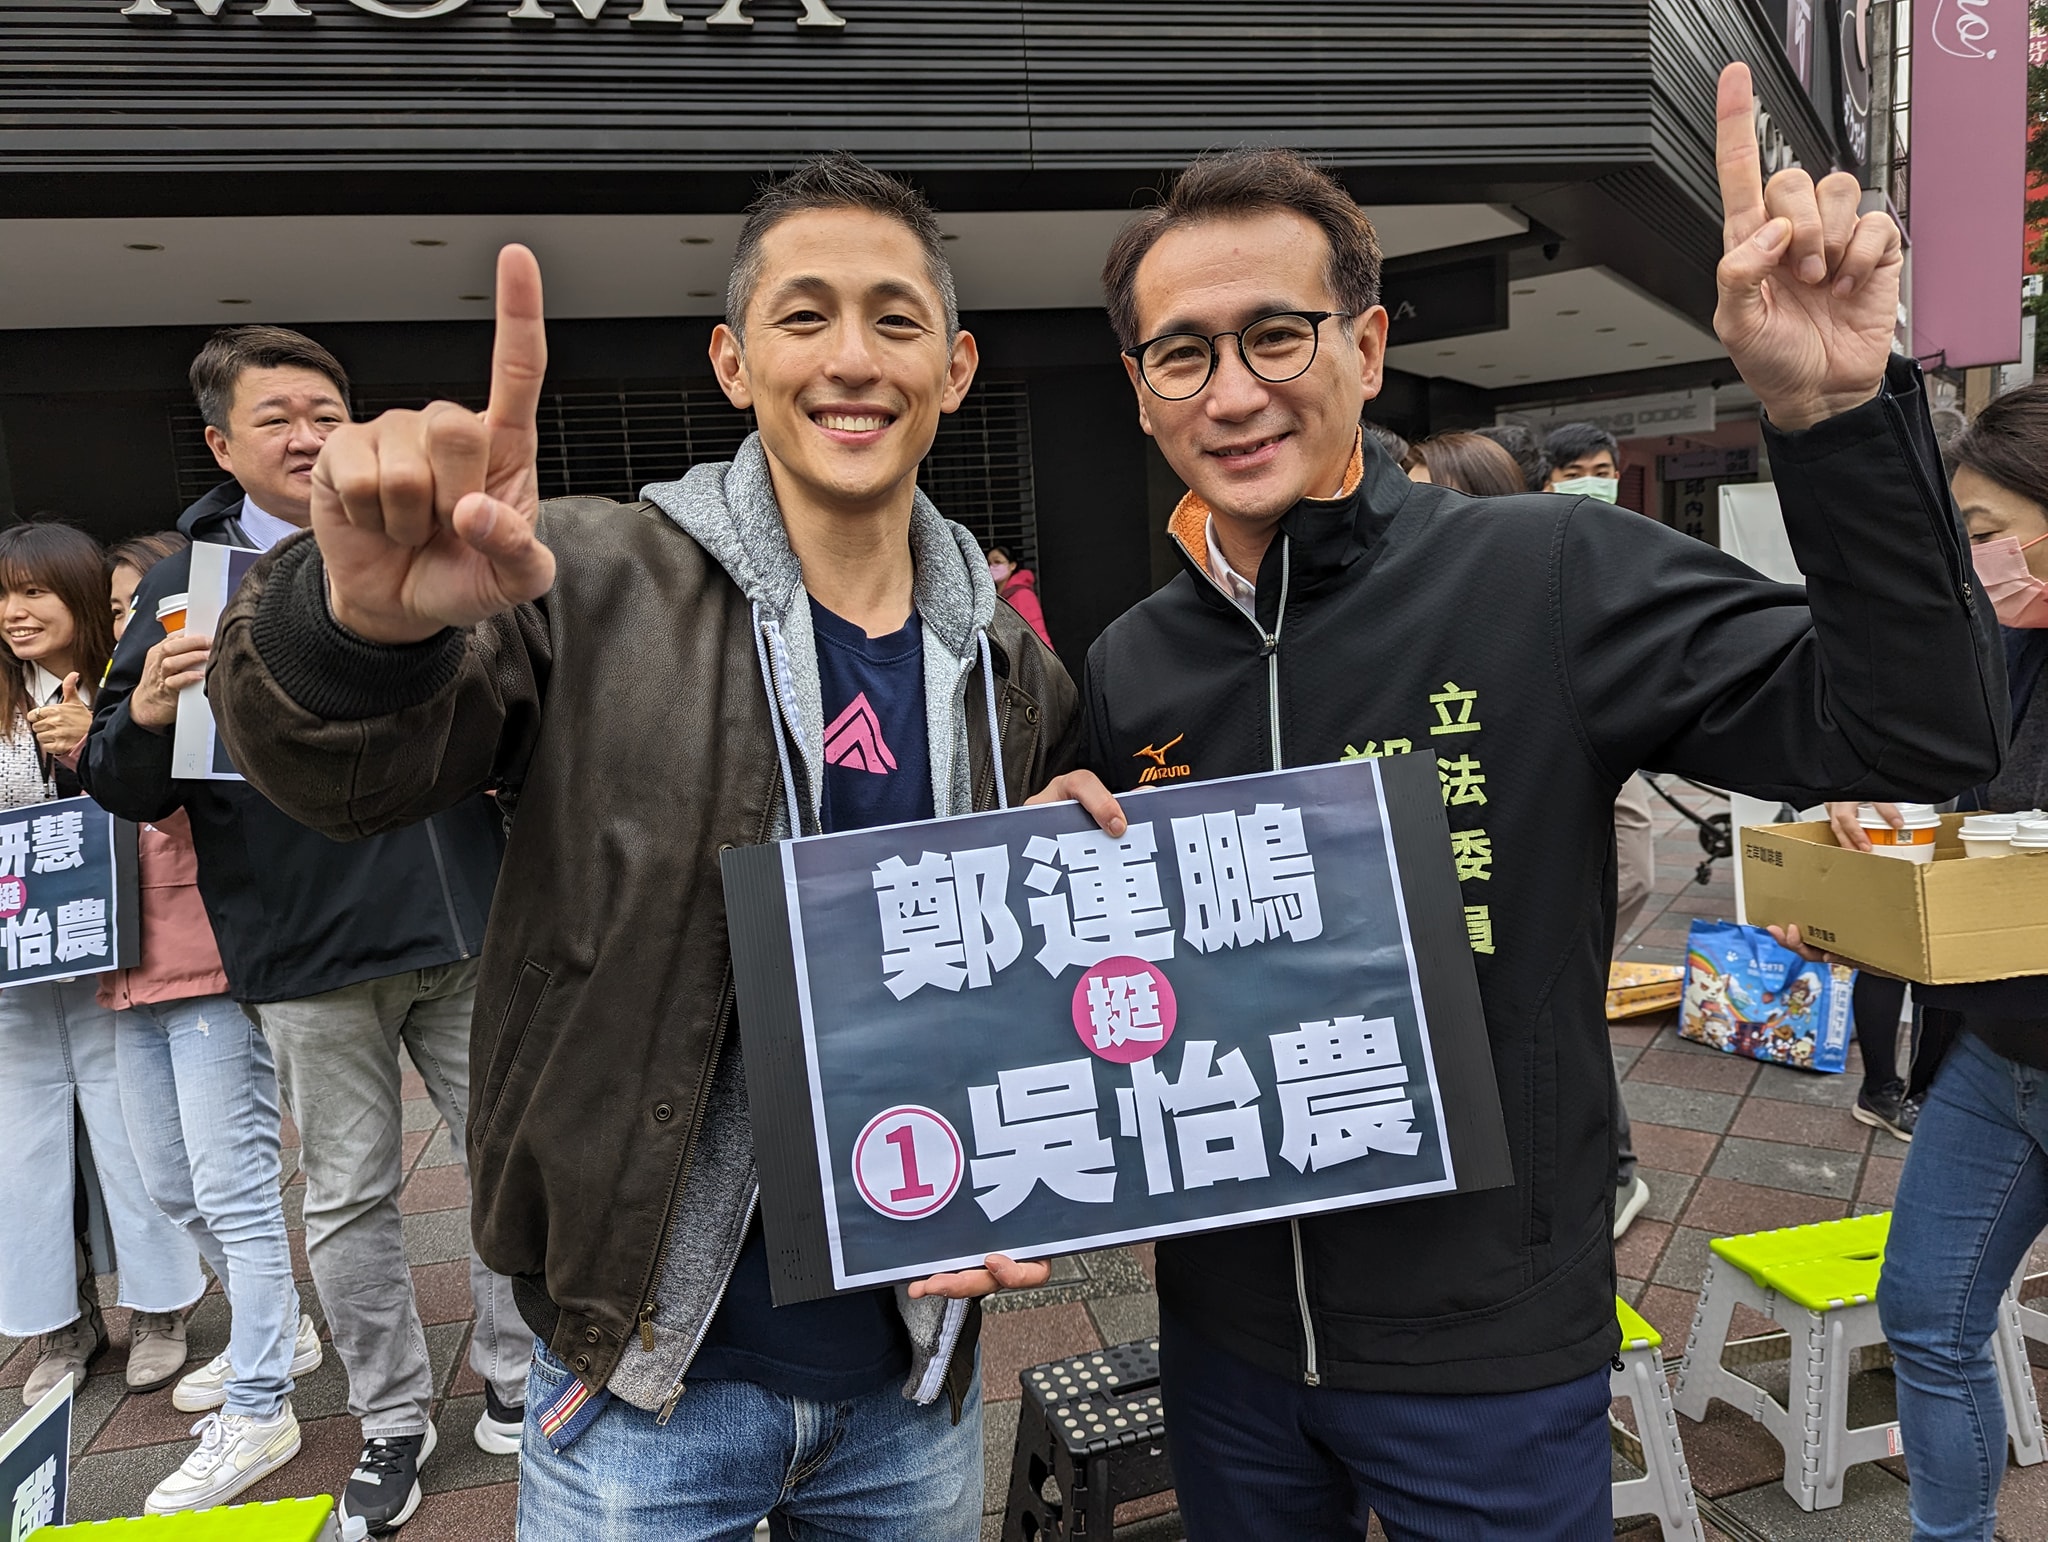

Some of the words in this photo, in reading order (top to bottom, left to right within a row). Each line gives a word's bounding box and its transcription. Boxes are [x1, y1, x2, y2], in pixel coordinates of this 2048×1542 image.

[871, 803, 1324, 1001] 鄭運鵬
[1429, 681, 1496, 955] 立法委員
[1086, 970, 1164, 1050] 挺
[885, 1124, 935, 1203] 1
[967, 1014, 1424, 1222] 吳怡農
